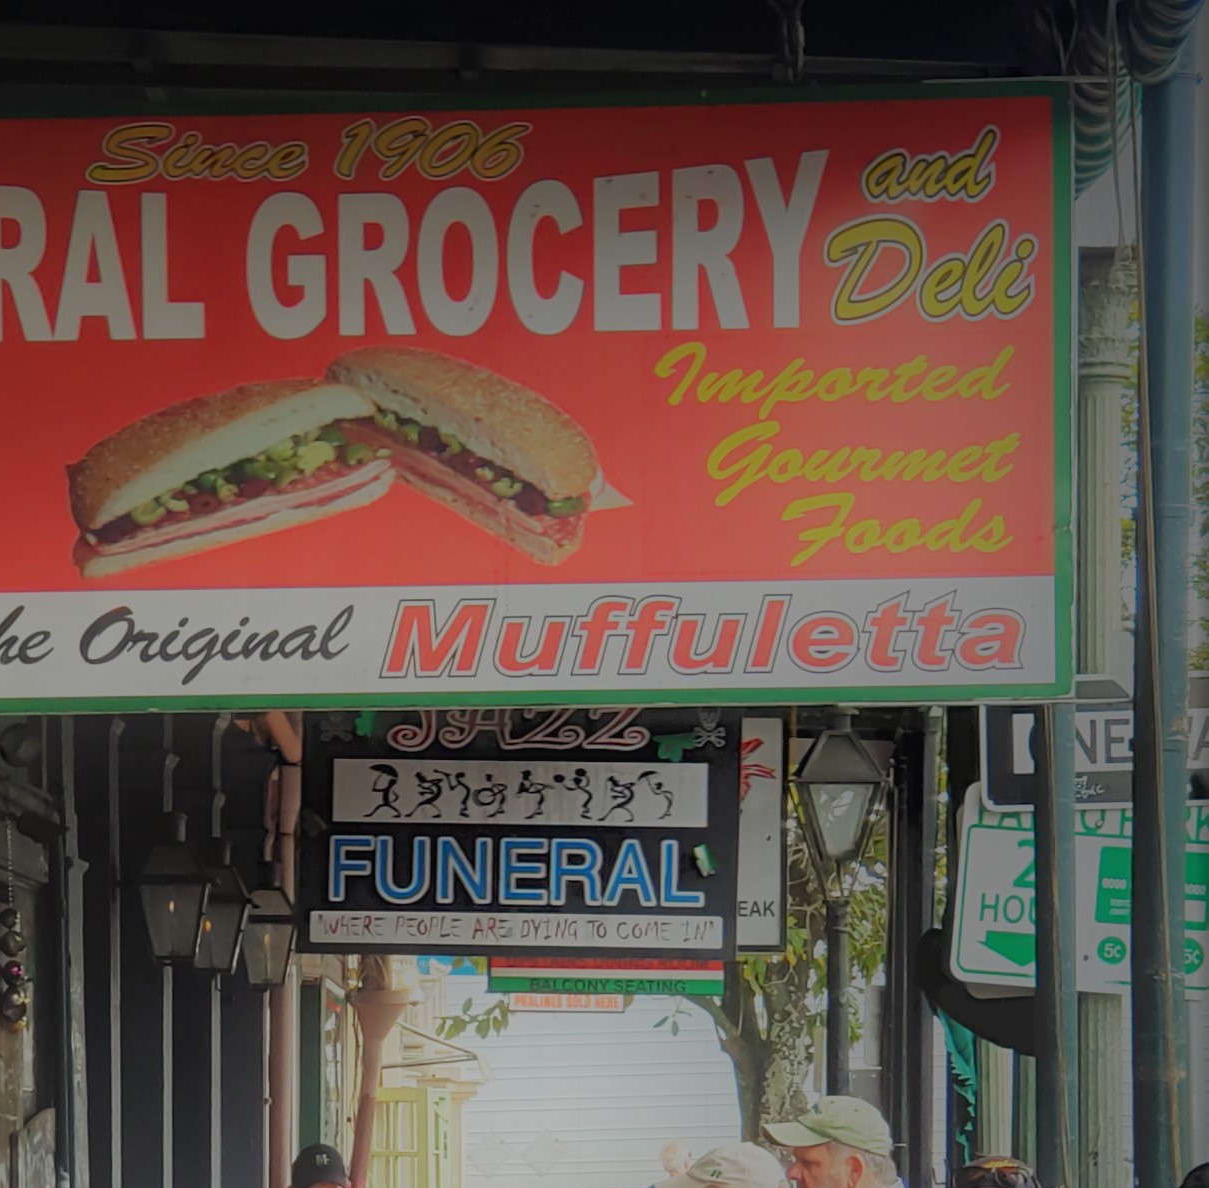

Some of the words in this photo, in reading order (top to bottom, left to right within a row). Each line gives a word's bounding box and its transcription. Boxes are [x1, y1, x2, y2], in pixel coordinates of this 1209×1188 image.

[85, 121, 310, 184] Since
[334, 117, 533, 181] 1906
[862, 125, 999, 203] and
[245, 149, 831, 340] GROCERY
[824, 214, 1040, 325] Deli
[654, 341, 1015, 411] Imported
[706, 420, 1022, 506] Gourmet
[781, 492, 1014, 567] Foods
[79, 604, 354, 685] Original
[379, 587, 1029, 682] Muffuletta
[328, 834, 705, 907] FUNERAL
[394, 915, 463, 938] PEOPLE
[471, 917, 509, 941] ARE
[520, 918, 578, 942] DYING
[587, 919, 607, 939] TO
[616, 921, 672, 941] COME
[738, 900, 776, 918] EAK
[530, 978, 609, 992] BALCONY
[614, 979, 687, 993] SEATING
